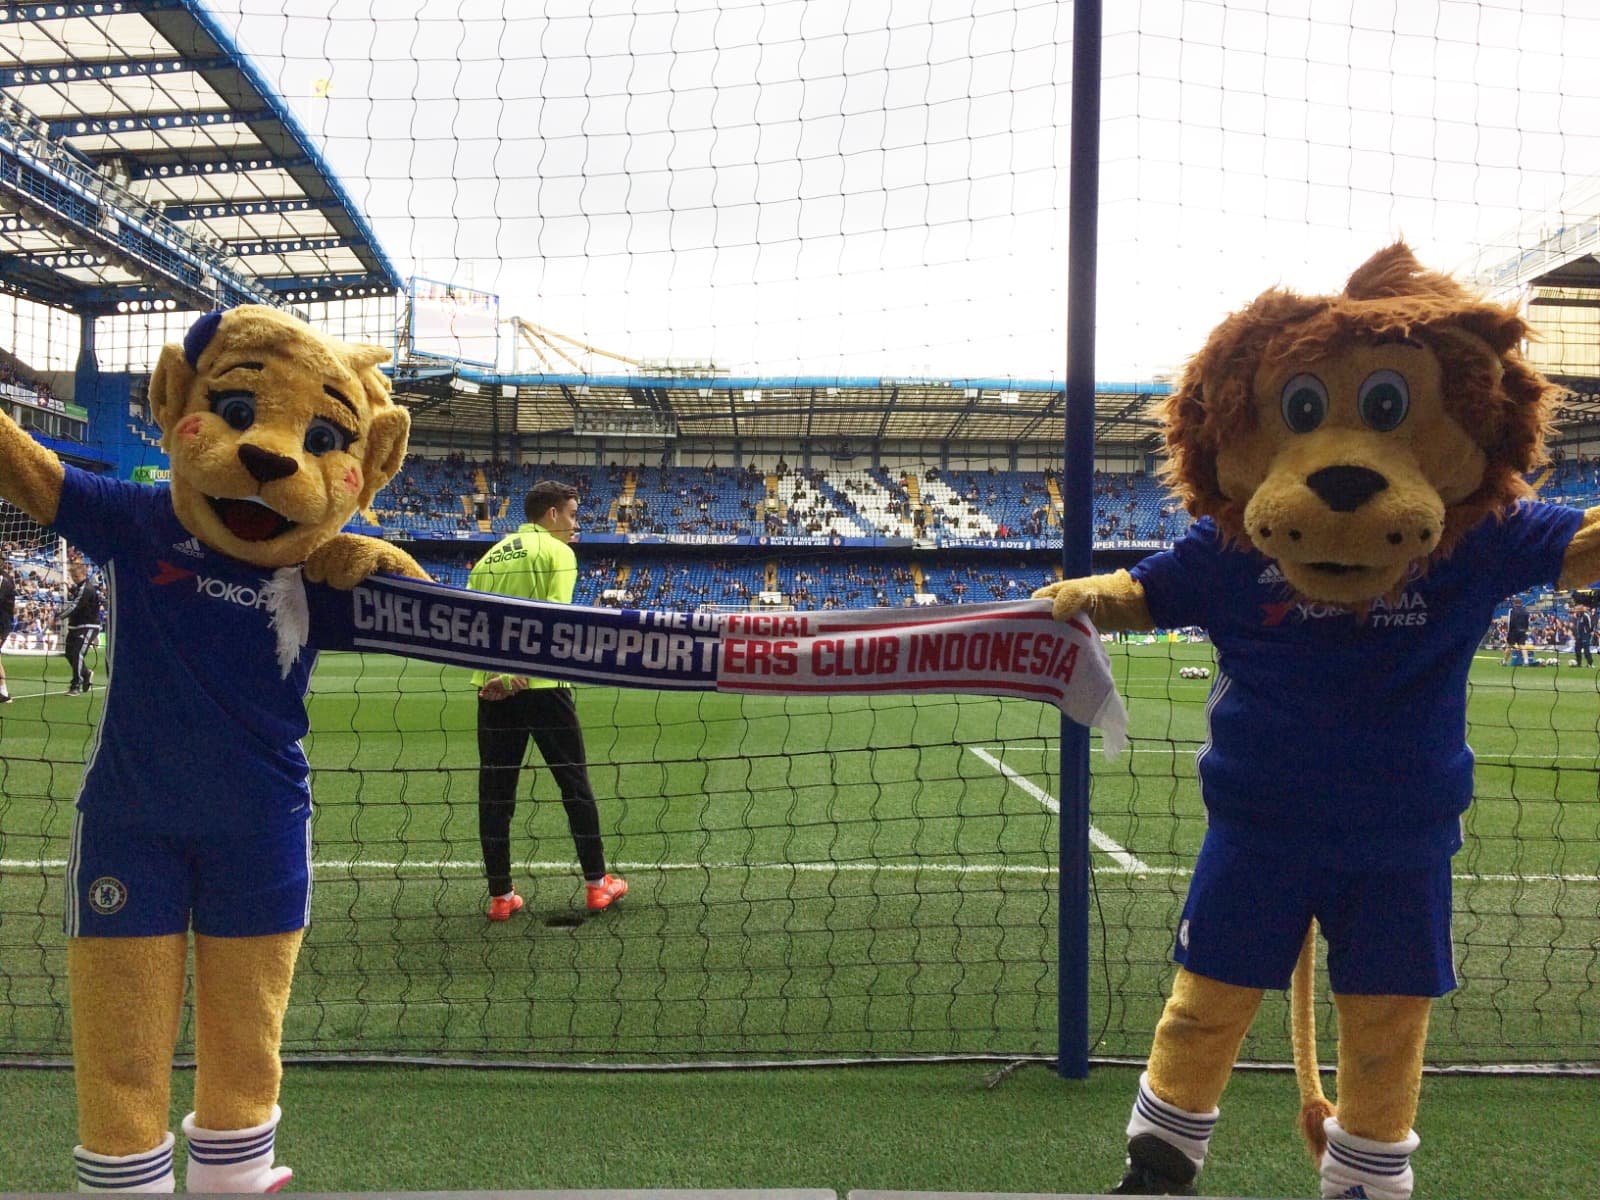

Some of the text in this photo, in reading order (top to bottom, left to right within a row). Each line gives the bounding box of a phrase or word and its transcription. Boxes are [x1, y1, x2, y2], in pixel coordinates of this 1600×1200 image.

[1092, 541, 1115, 549] UPER
[1117, 540, 1160, 548] FRANKIE
[485, 549, 528, 564] adidas
[196, 575, 274, 612] YOKOH
[639, 610, 817, 638] THE OFFICIAL
[1372, 612, 1427, 628] TYRES
[353, 586, 1080, 685] CHELSEA FC SUPPORTERS CLUB INDONESIA
